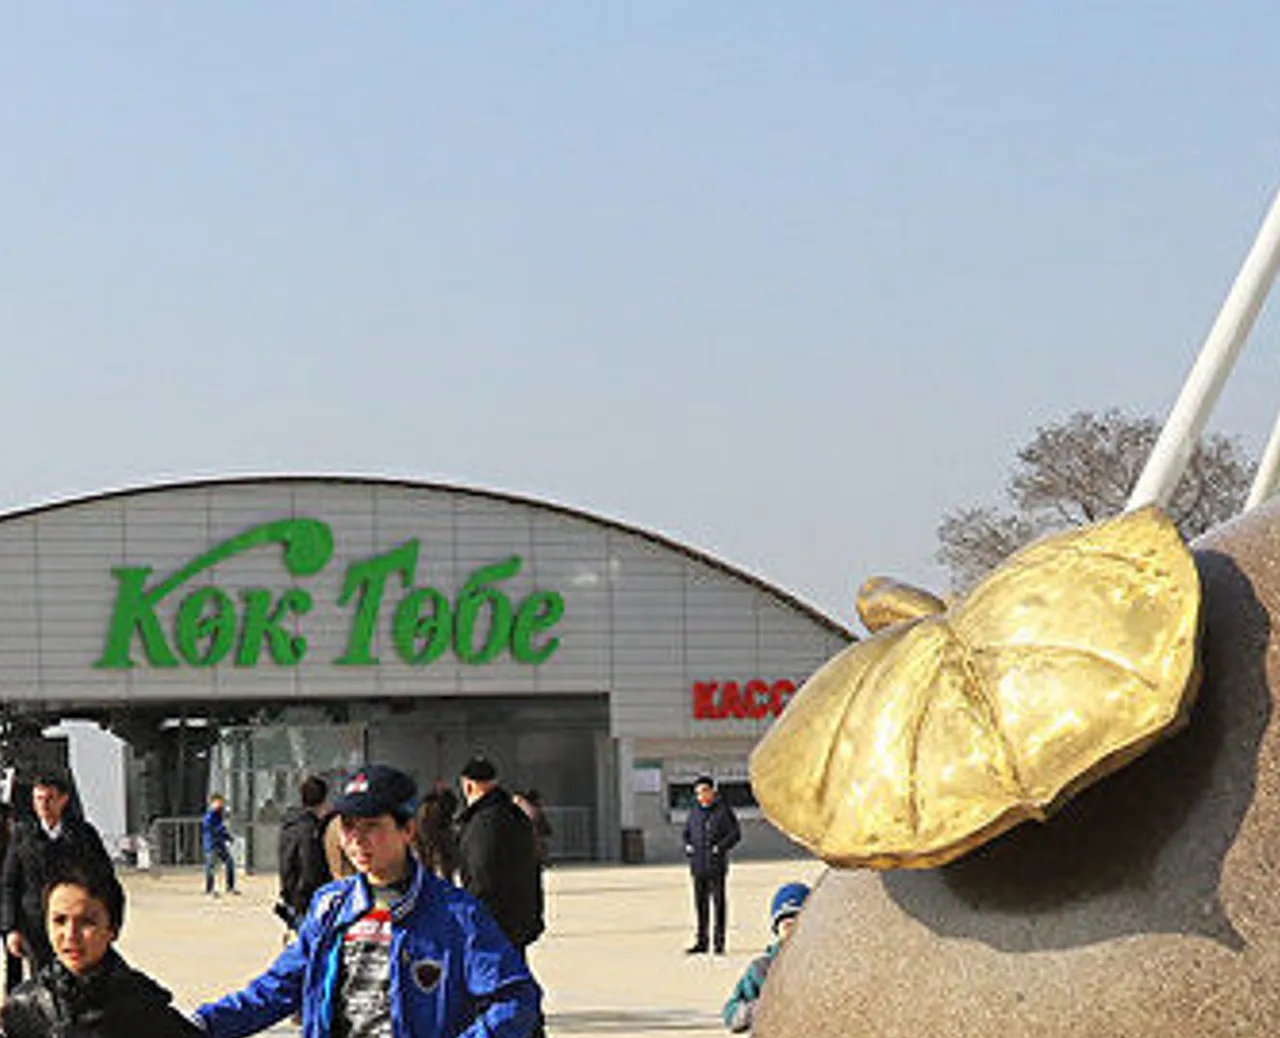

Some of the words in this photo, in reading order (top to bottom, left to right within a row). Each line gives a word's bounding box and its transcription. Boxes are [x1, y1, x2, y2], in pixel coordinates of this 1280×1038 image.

[91, 517, 334, 669] Көк
[331, 537, 565, 667] Төбе
[691, 678, 805, 721] КАСС
